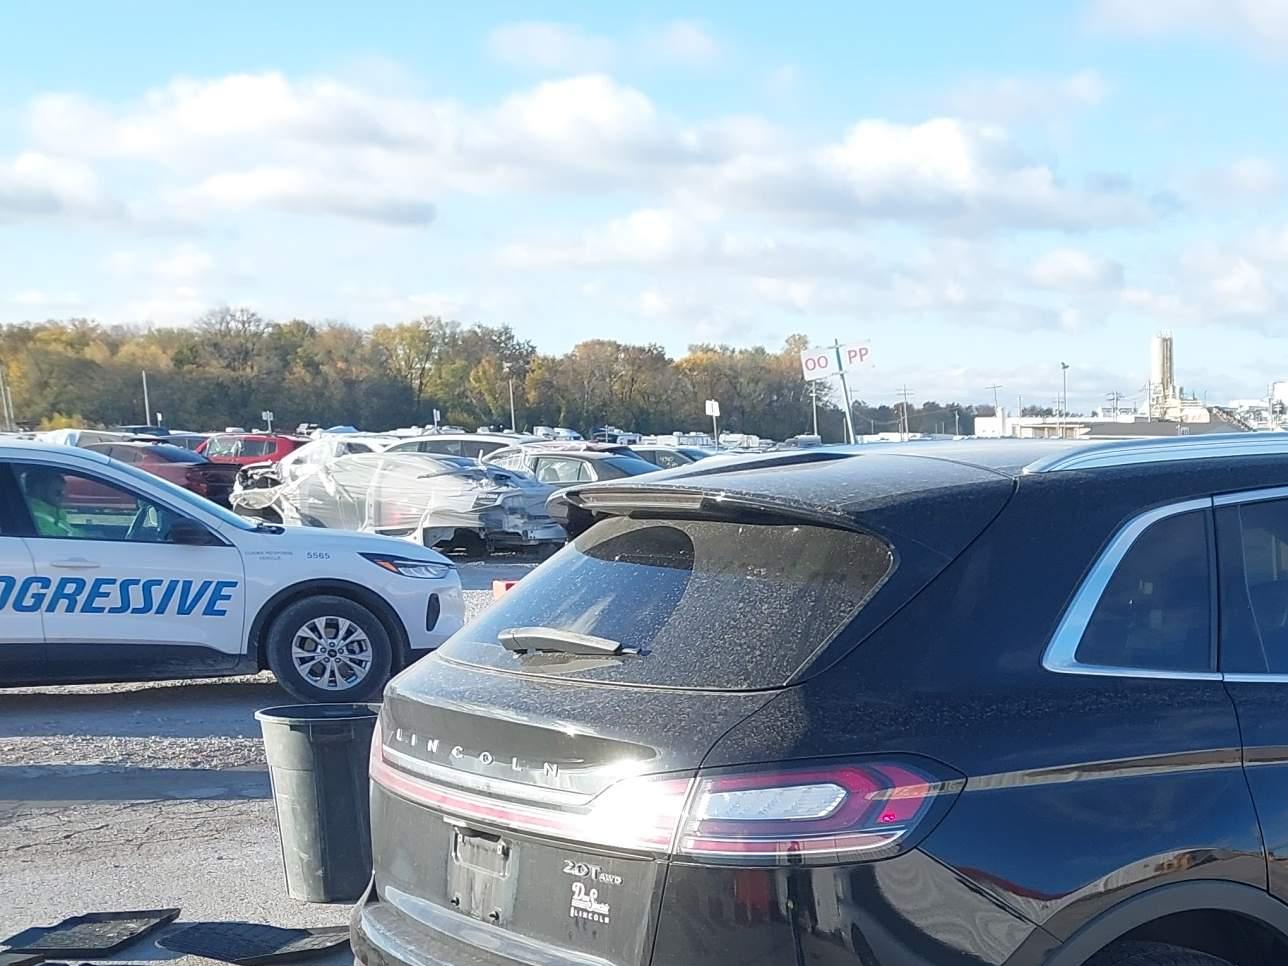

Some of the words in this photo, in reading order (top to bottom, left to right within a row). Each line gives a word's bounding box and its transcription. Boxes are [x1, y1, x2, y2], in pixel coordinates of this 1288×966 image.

[804, 355, 829, 372] OO
[847, 346, 869, 365] PP
[396, 727, 559, 778] LINCOLN
